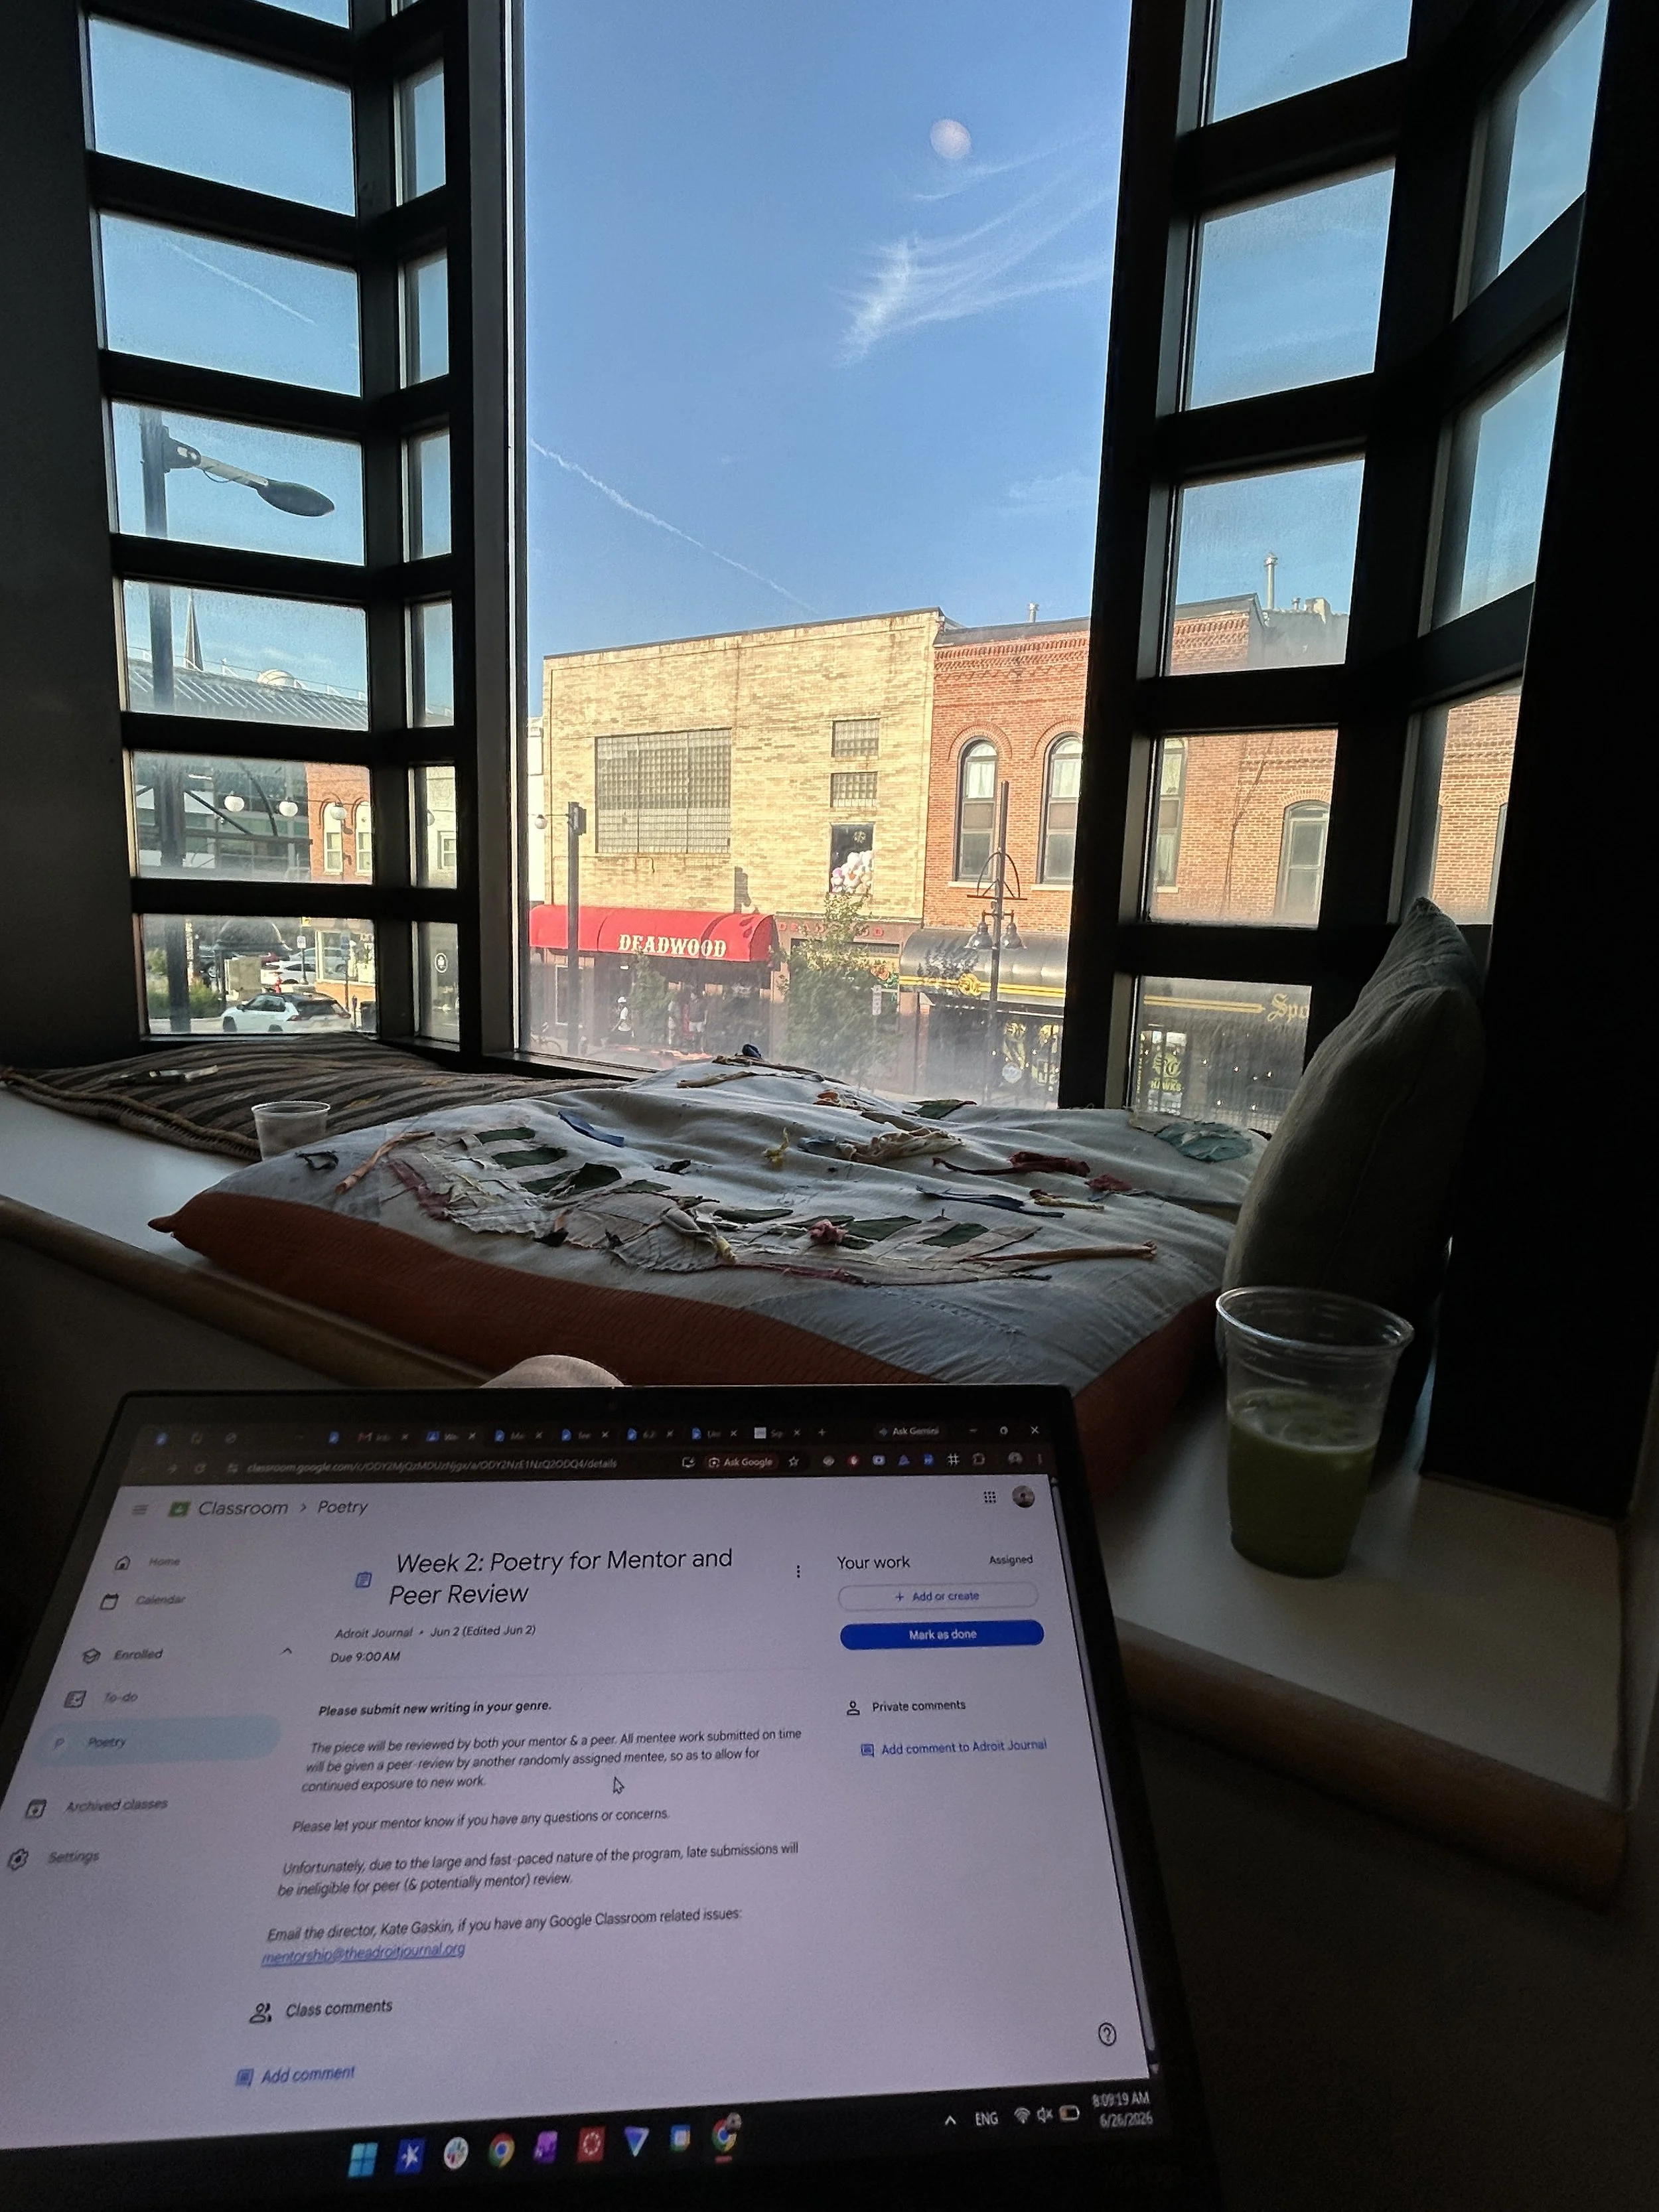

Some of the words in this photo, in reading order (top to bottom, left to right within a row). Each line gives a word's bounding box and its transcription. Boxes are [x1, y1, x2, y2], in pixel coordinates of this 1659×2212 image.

[618, 934, 727, 958] DEADWOOD
[724, 1458, 740, 1467] Ask
[742, 1457, 773, 1469] Google
[199, 1501, 288, 1515] Classroom
[318, 1500, 368, 1516] Poetry
[149, 1557, 180, 1566] Home
[397, 1553, 459, 1573] Week
[465, 1552, 484, 1572] 2:
[490, 1552, 563, 1574] Poetry
[570, 1551, 602, 1570] for
[608, 1550, 687, 1569] Mentor
[692, 1548, 733, 1568] and
[837, 1556, 870, 1569] Your
[874, 1555, 910, 1568] work
[989, 1555, 1033, 1566] Assigned
[136, 1594, 186, 1605] Calendar
[389, 1585, 441, 1605] Peer
[448, 1584, 529, 1603] Review
[913, 1592, 932, 1601] Add
[948, 1591, 979, 1601] create
[334, 1628, 369, 1639] Adroit
[372, 1627, 414, 1639] Journal
[430, 1627, 452, 1637] Jun
[453, 1627, 459, 1636] 2
[463, 1625, 500, 1638] (Edited
[503, 1625, 524, 1636] Jun
[526, 1625, 536, 1637] 2)
[909, 1630, 935, 1640] Mark
[951, 1629, 977, 1639] done
[114, 1649, 164, 1660] Enrolled
[330, 1653, 352, 1662] Due
[319, 1705, 357, 1717] Please
[360, 1704, 401, 1715] submit
[403, 1706, 427, 1714] new
[430, 1701, 470, 1714] writing
[473, 1702, 484, 1712] in
[486, 1703, 512, 1714] your
[516, 1701, 551, 1714] genre.
[872, 1700, 908, 1712] Private
[912, 1700, 966, 1712] comments
[88, 1737, 127, 1749] Poetry
[311, 1741, 331, 1753] The
[333, 1742, 364, 1755] piece
[368, 1739, 386, 1752] will
[388, 1739, 402, 1751] be
[404, 1738, 455, 1751] reviewed
[457, 1737, 470, 1751] by
[473, 1736, 498, 1749] both
[501, 1738, 526, 1750] your
[528, 1735, 567, 1747] mentor
[570, 1735, 578, 1745] &
[620, 1732, 634, 1743] All
[636, 1733, 676, 1743] mentee
[679, 1731, 705, 1741] work
[707, 1729, 759, 1741] submitted
[762, 1731, 776, 1739] on
[778, 1729, 802, 1739] time
[882, 1743, 902, 1755] Add
[906, 1742, 956, 1754] comment
[959, 1742, 970, 1753] to
[973, 1741, 1005, 1752] Adroit
[1008, 1739, 1047, 1751] Journal
[305, 1760, 325, 1773] will
[327, 1759, 341, 1772] be
[344, 1759, 374, 1775] given
[377, 1761, 384, 1771] a
[457, 1756, 472, 1769] by
[473, 1755, 515, 1767] another
[518, 1754, 569, 1768] randomly
[573, 1751, 621, 1767] assigned
[624, 1752, 667, 1763] mentee,
[670, 1752, 683, 1761] so
[686, 1751, 698, 1761] as
[701, 1749, 712, 1760] to
[715, 1747, 743, 1759] allow
[745, 1747, 760, 1759] for
[301, 1779, 359, 1792] continued
[361, 1778, 413, 1793] exposure
[416, 1777, 428, 1789] to
[431, 1777, 454, 1788] new
[65, 1799, 121, 1812] Archived
[123, 1798, 169, 1810] classes
[292, 1820, 331, 1832] Please
[334, 1819, 349, 1831] let
[351, 1820, 378, 1834] your
[380, 1817, 421, 1830] mentor
[424, 1815, 455, 1828] know
[457, 1813, 467, 1826] if
[467, 1816, 488, 1830] you
[491, 1812, 517, 1825] have
[520, 1814, 541, 1826] any
[543, 1811, 599, 1826] questions
[601, 1811, 614, 1822] or
[48, 1850, 100, 1864] Settings
[283, 1862, 366, 1876] Unfortunately,
[369, 1859, 392, 1871] due
[395, 1859, 408, 1870] to
[411, 1857, 429, 1870] the
[432, 1856, 461, 1871] large
[464, 1855, 486, 1867] and
[556, 1850, 593, 1863] nature
[596, 1848, 609, 1862] of
[611, 1848, 629, 1861] the
[632, 1848, 683, 1863] program,
[686, 1845, 707, 1858] late
[710, 1843, 778, 1856] submissions
[781, 1842, 798, 1854] will
[277, 1883, 294, 1896] be
[296, 1881, 349, 1897] ineligible
[353, 1880, 369, 1893] for
[372, 1881, 399, 1895] peer
[403, 1878, 417, 1892] (&
[420, 1875, 481, 1891] potentially
[484, 1873, 530, 1887] mentor)
[267, 1927, 300, 1942] Email
[304, 1926, 324, 1939] the
[327, 1923, 376, 1939] director,
[380, 1922, 408, 1936] Kate
[411, 1921, 455, 1935] Gaskin,
[458, 1917, 467, 1932] if
[469, 1919, 490, 1933] you
[494, 1917, 522, 1930] have
[525, 1917, 547, 1931] any
[549, 1913, 592, 1929] Google
[595, 1911, 657, 1926] Classroom
[660, 1909, 700, 1922] related
[261, 1943, 465, 1965] mentorship@theadroitjournal.org
[286, 2003, 322, 2018] Class
[325, 2000, 394, 2016] comments
[261, 2068, 289, 2085] Add
[293, 2066, 355, 2083] comment
[1131, 2091, 1151, 2104] AM
[975, 2112, 998, 2126] ENG
